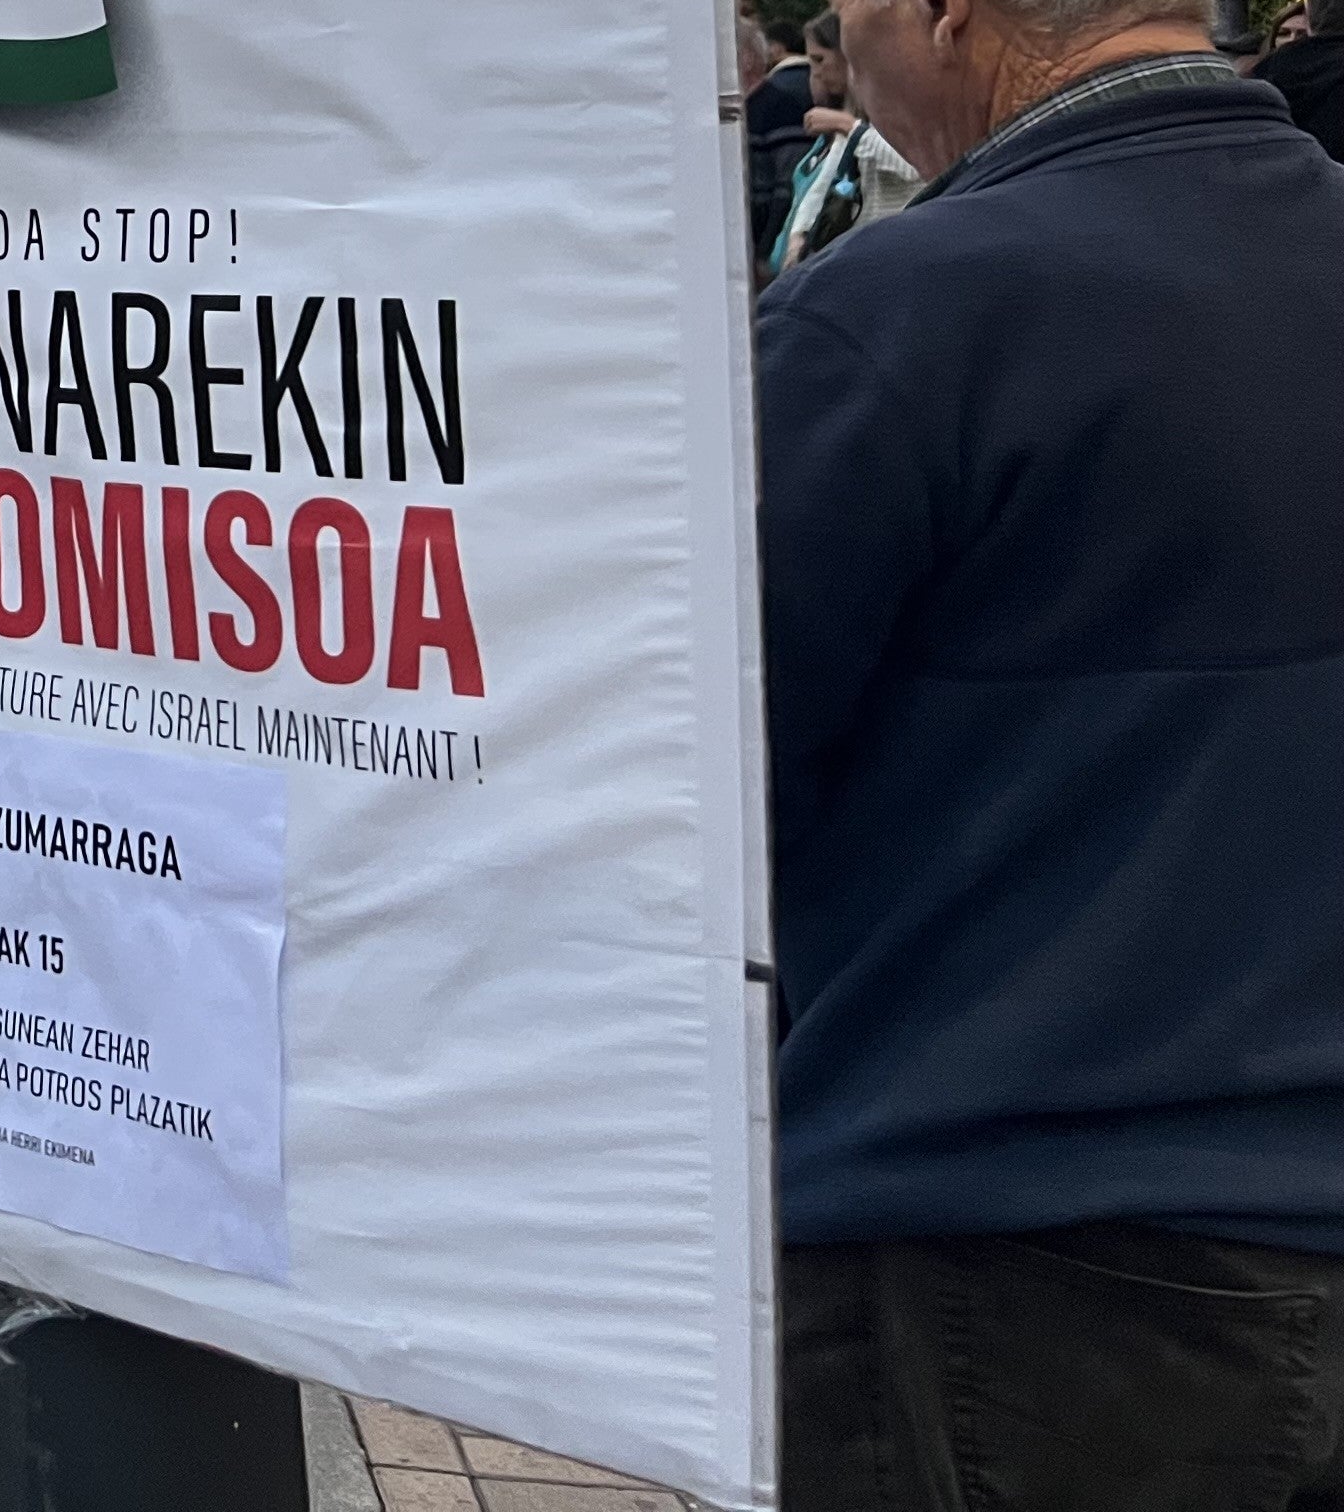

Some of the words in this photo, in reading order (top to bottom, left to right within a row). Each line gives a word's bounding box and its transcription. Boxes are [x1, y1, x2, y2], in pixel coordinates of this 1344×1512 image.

[80, 207, 242, 265] STOP!
[70, 678, 141, 734] AVEC
[149, 689, 246, 752] ISRAEL
[257, 705, 458, 781] MAINTENANT
[39, 933, 64, 974] 15
[81, 1026, 150, 1072] ZEHAR
[17, 1063, 101, 1111] POTROS
[111, 1084, 213, 1142] PLAZATIK
